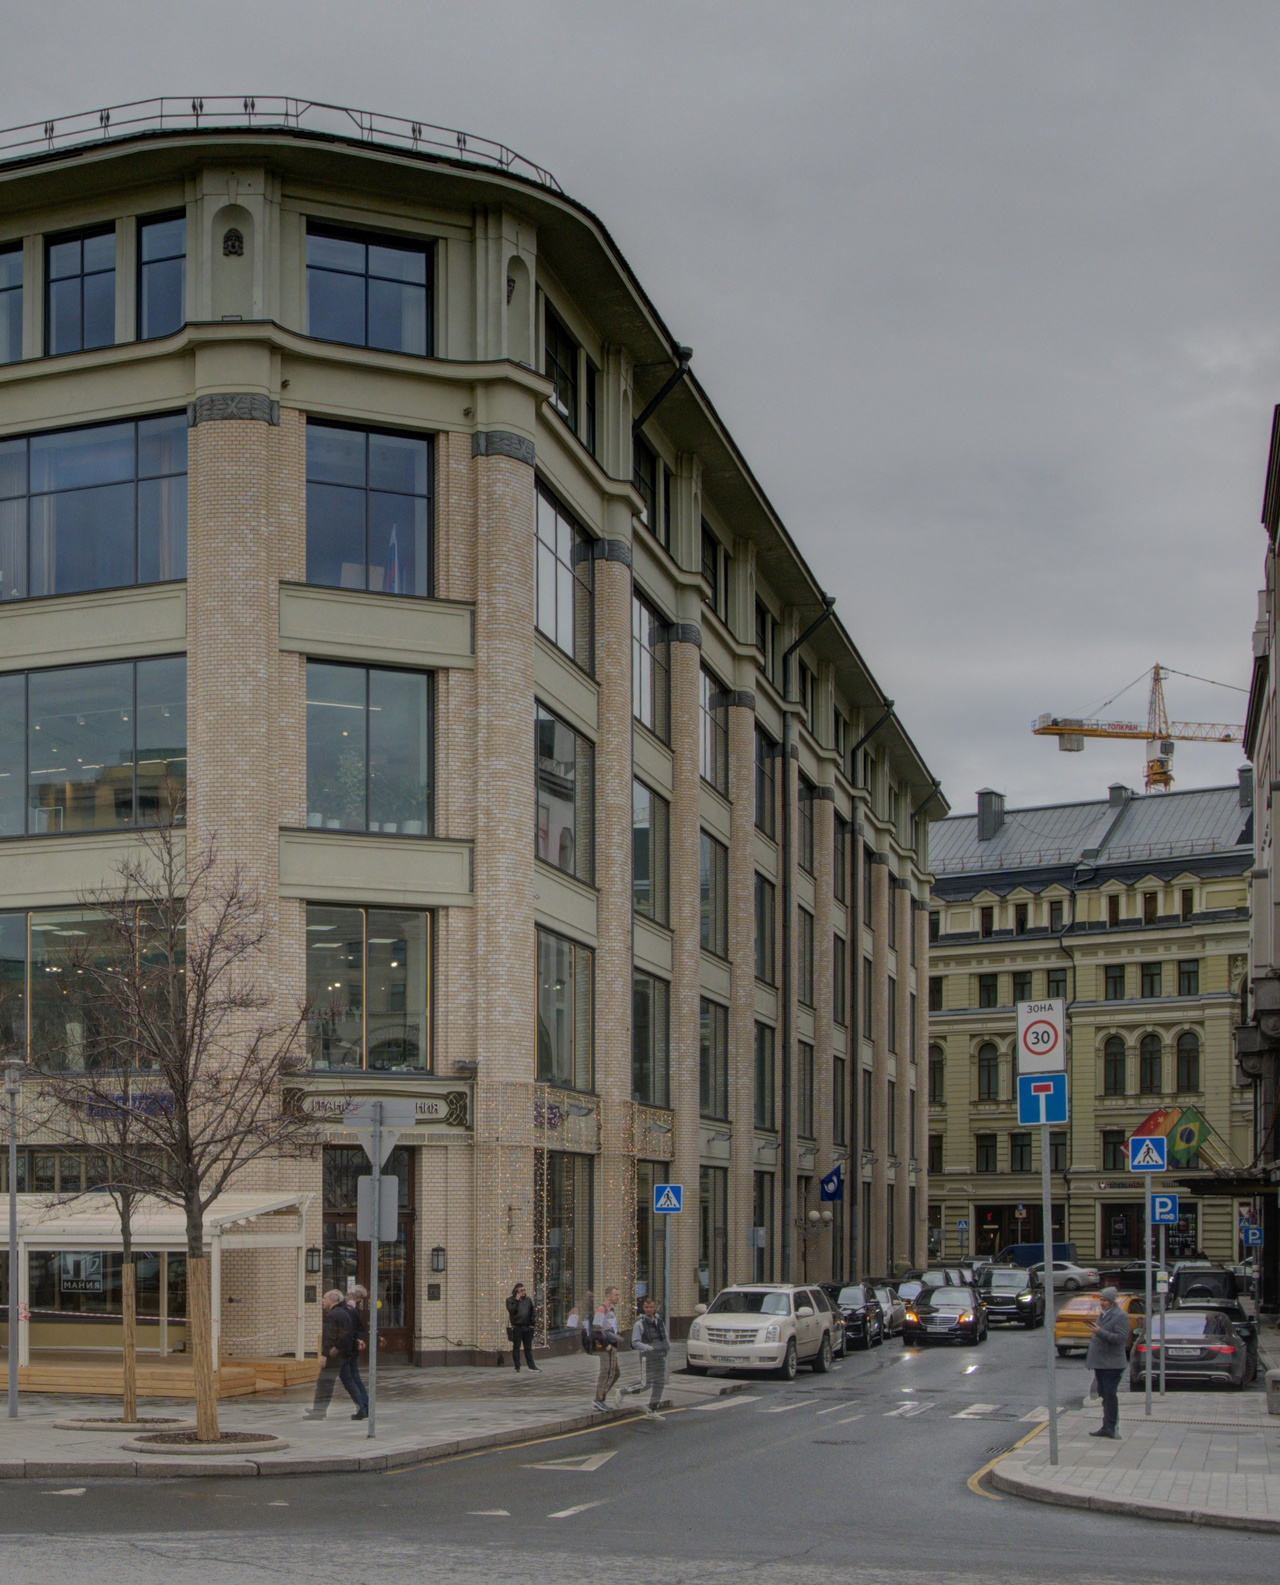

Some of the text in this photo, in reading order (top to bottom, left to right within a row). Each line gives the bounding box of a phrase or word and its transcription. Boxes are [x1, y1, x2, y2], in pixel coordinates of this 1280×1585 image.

[1107, 723, 1139, 731] ТОПКРАН
[1026, 1003, 1054, 1014] ЗОНА
[1031, 1030, 1051, 1045] 30
[1154, 1197, 1173, 1221] P
[63, 1280, 100, 1290] МАНИЯ
